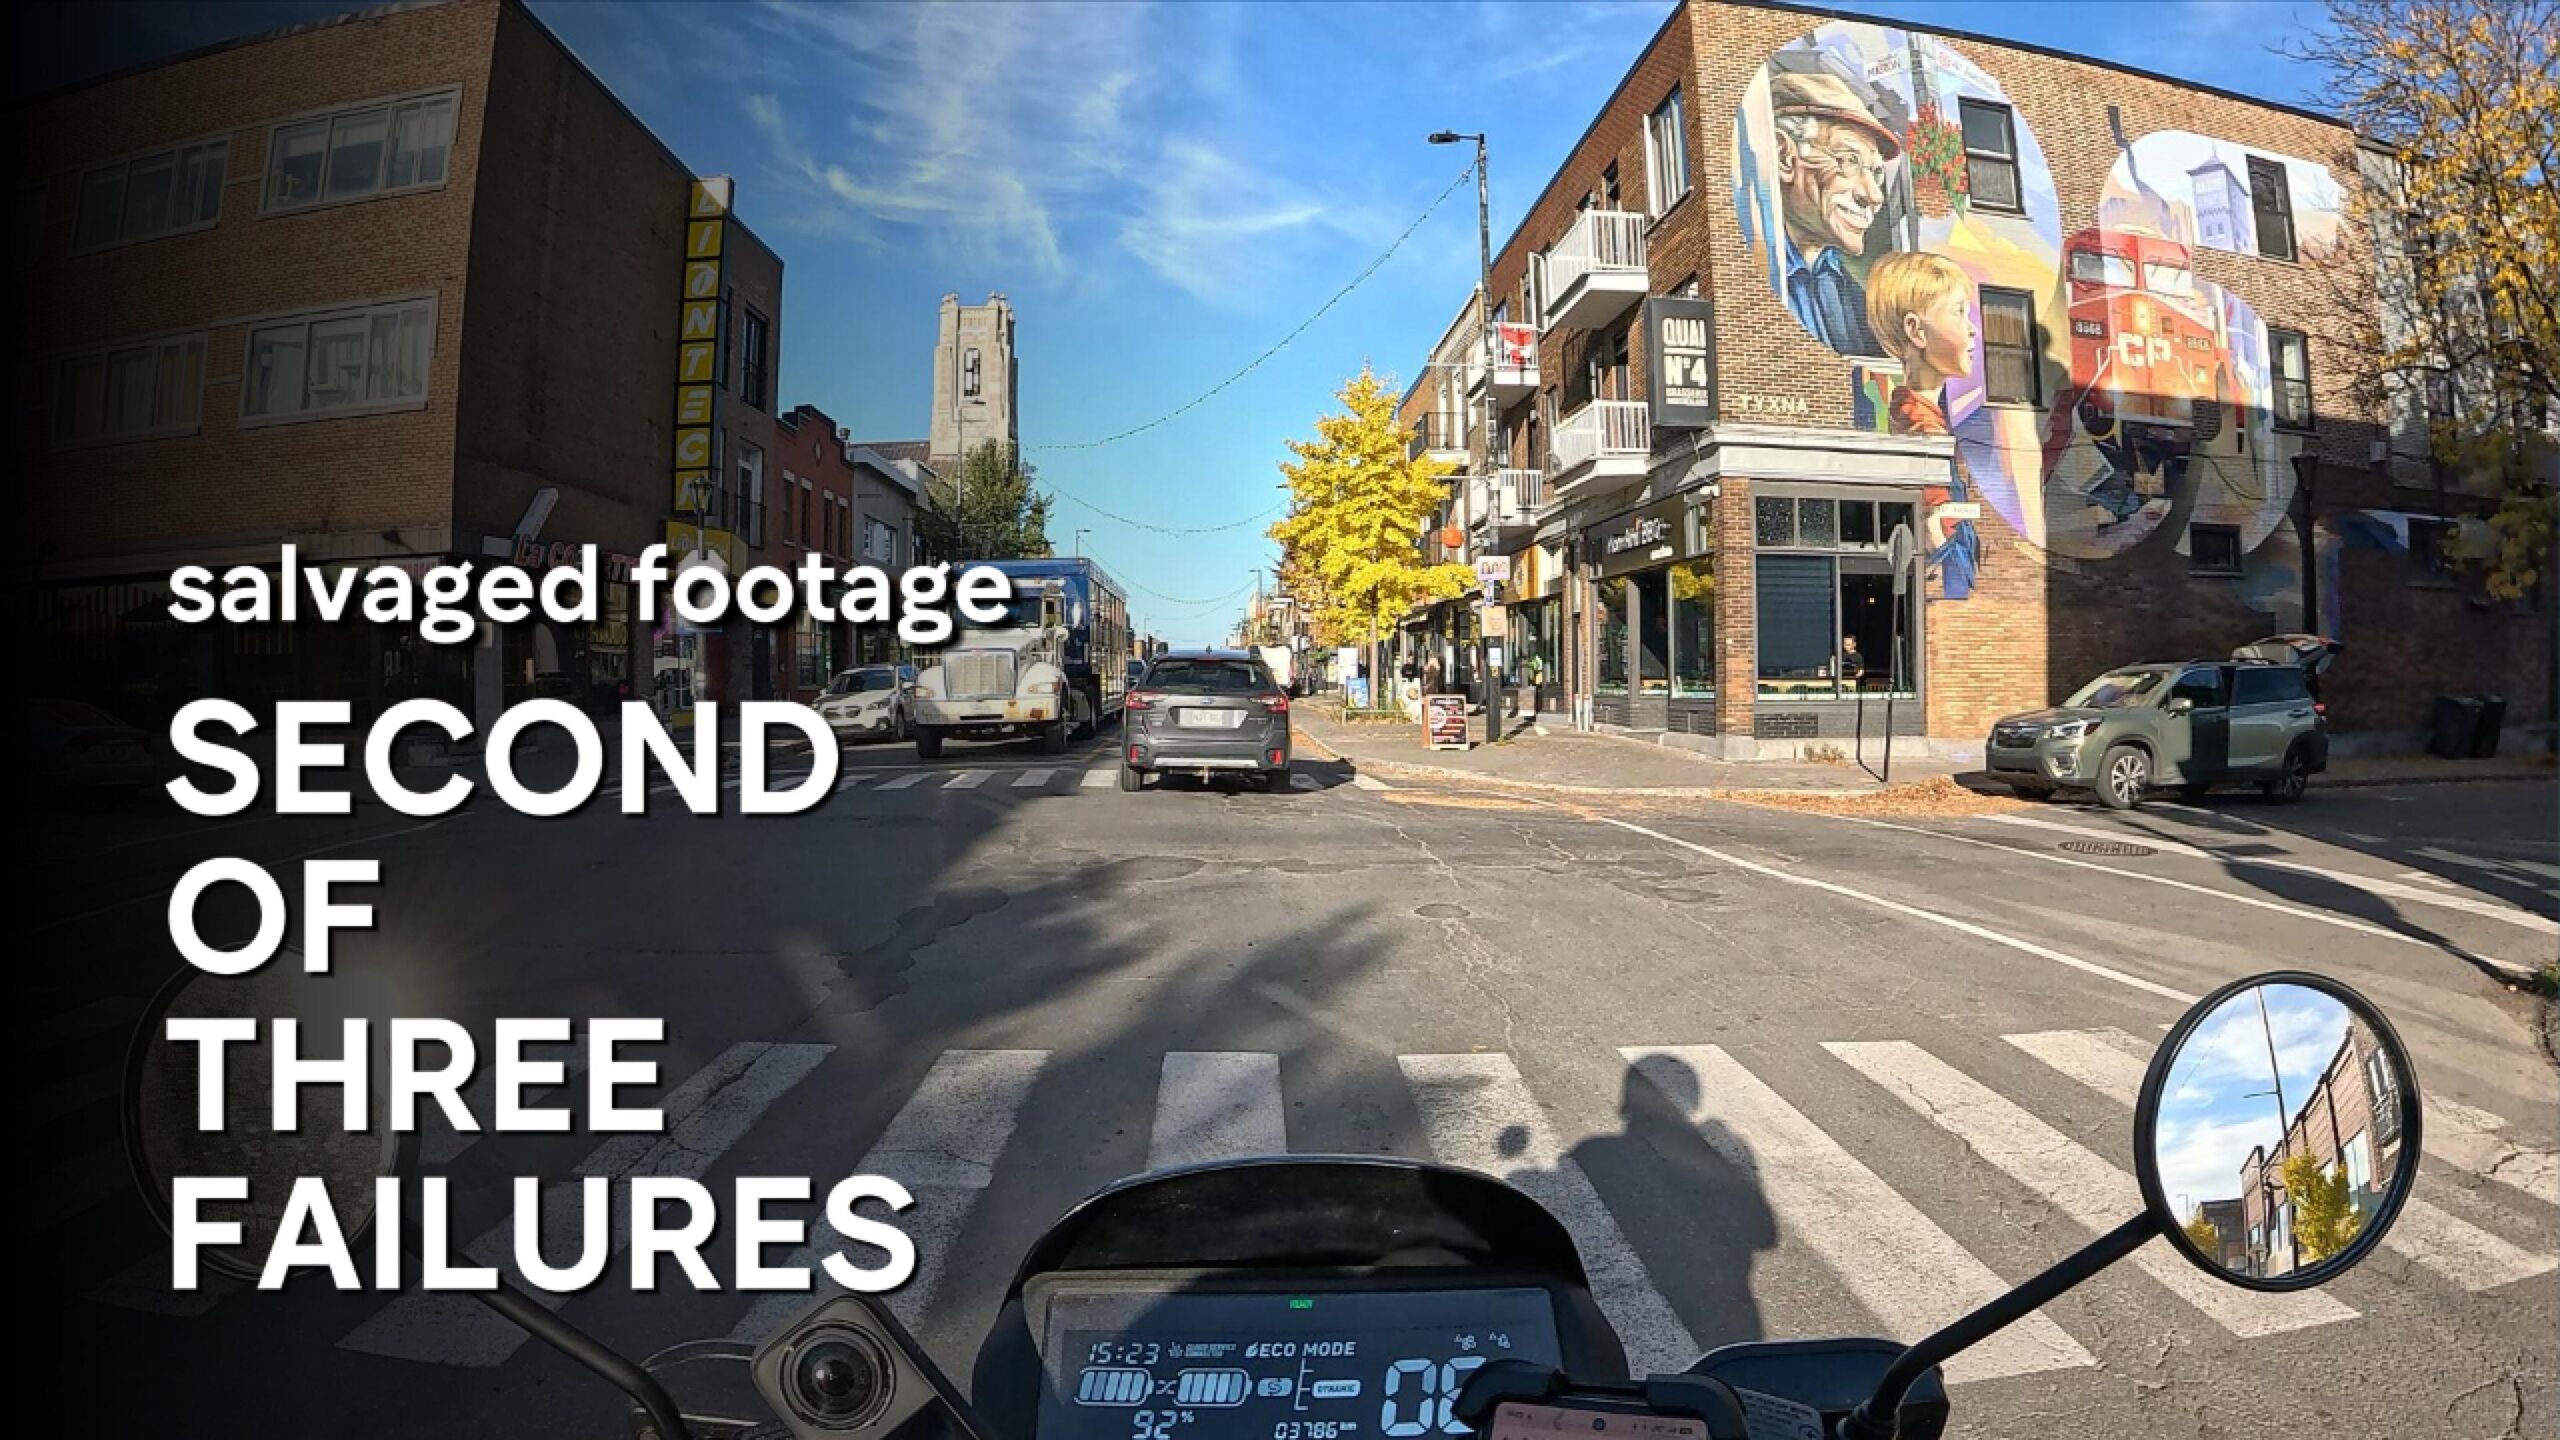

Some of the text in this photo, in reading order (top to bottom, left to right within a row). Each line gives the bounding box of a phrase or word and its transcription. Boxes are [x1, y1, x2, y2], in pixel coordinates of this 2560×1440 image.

[1662, 318, 1706, 348] QUAI
[2117, 331, 2171, 367] CP
[1089, 1342, 1160, 1365] 15:23
[1259, 1341, 1357, 1357] ECO MODE
